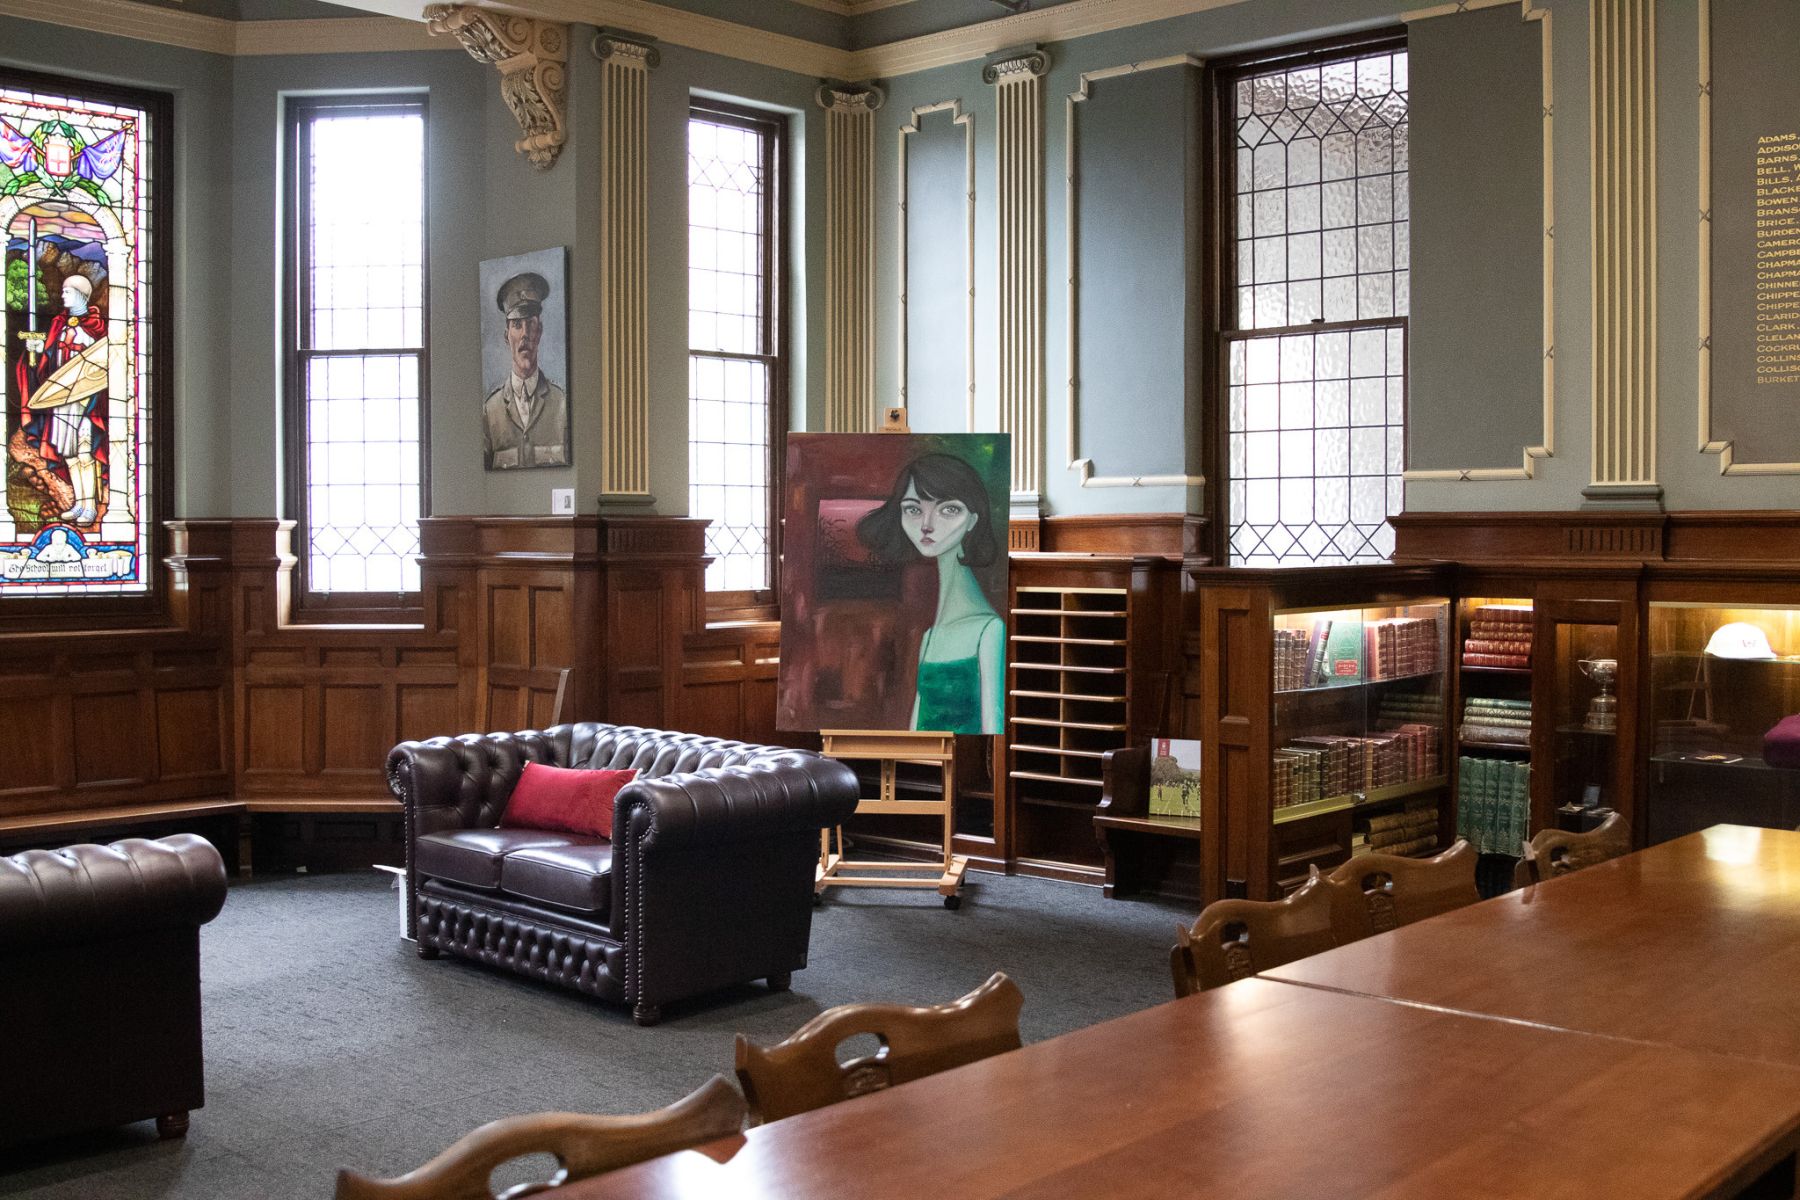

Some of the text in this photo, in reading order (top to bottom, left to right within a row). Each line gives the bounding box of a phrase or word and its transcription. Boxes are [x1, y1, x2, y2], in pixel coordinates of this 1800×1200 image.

[1757, 143, 1800, 154] ADDISO
[1757, 207, 1800, 217] BRANS
[1757, 312, 1800, 321] CLARID
[26, 562, 49, 573] School
[51, 563, 66, 573] will
[68, 563, 81, 573] not
[83, 563, 107, 573] forget
